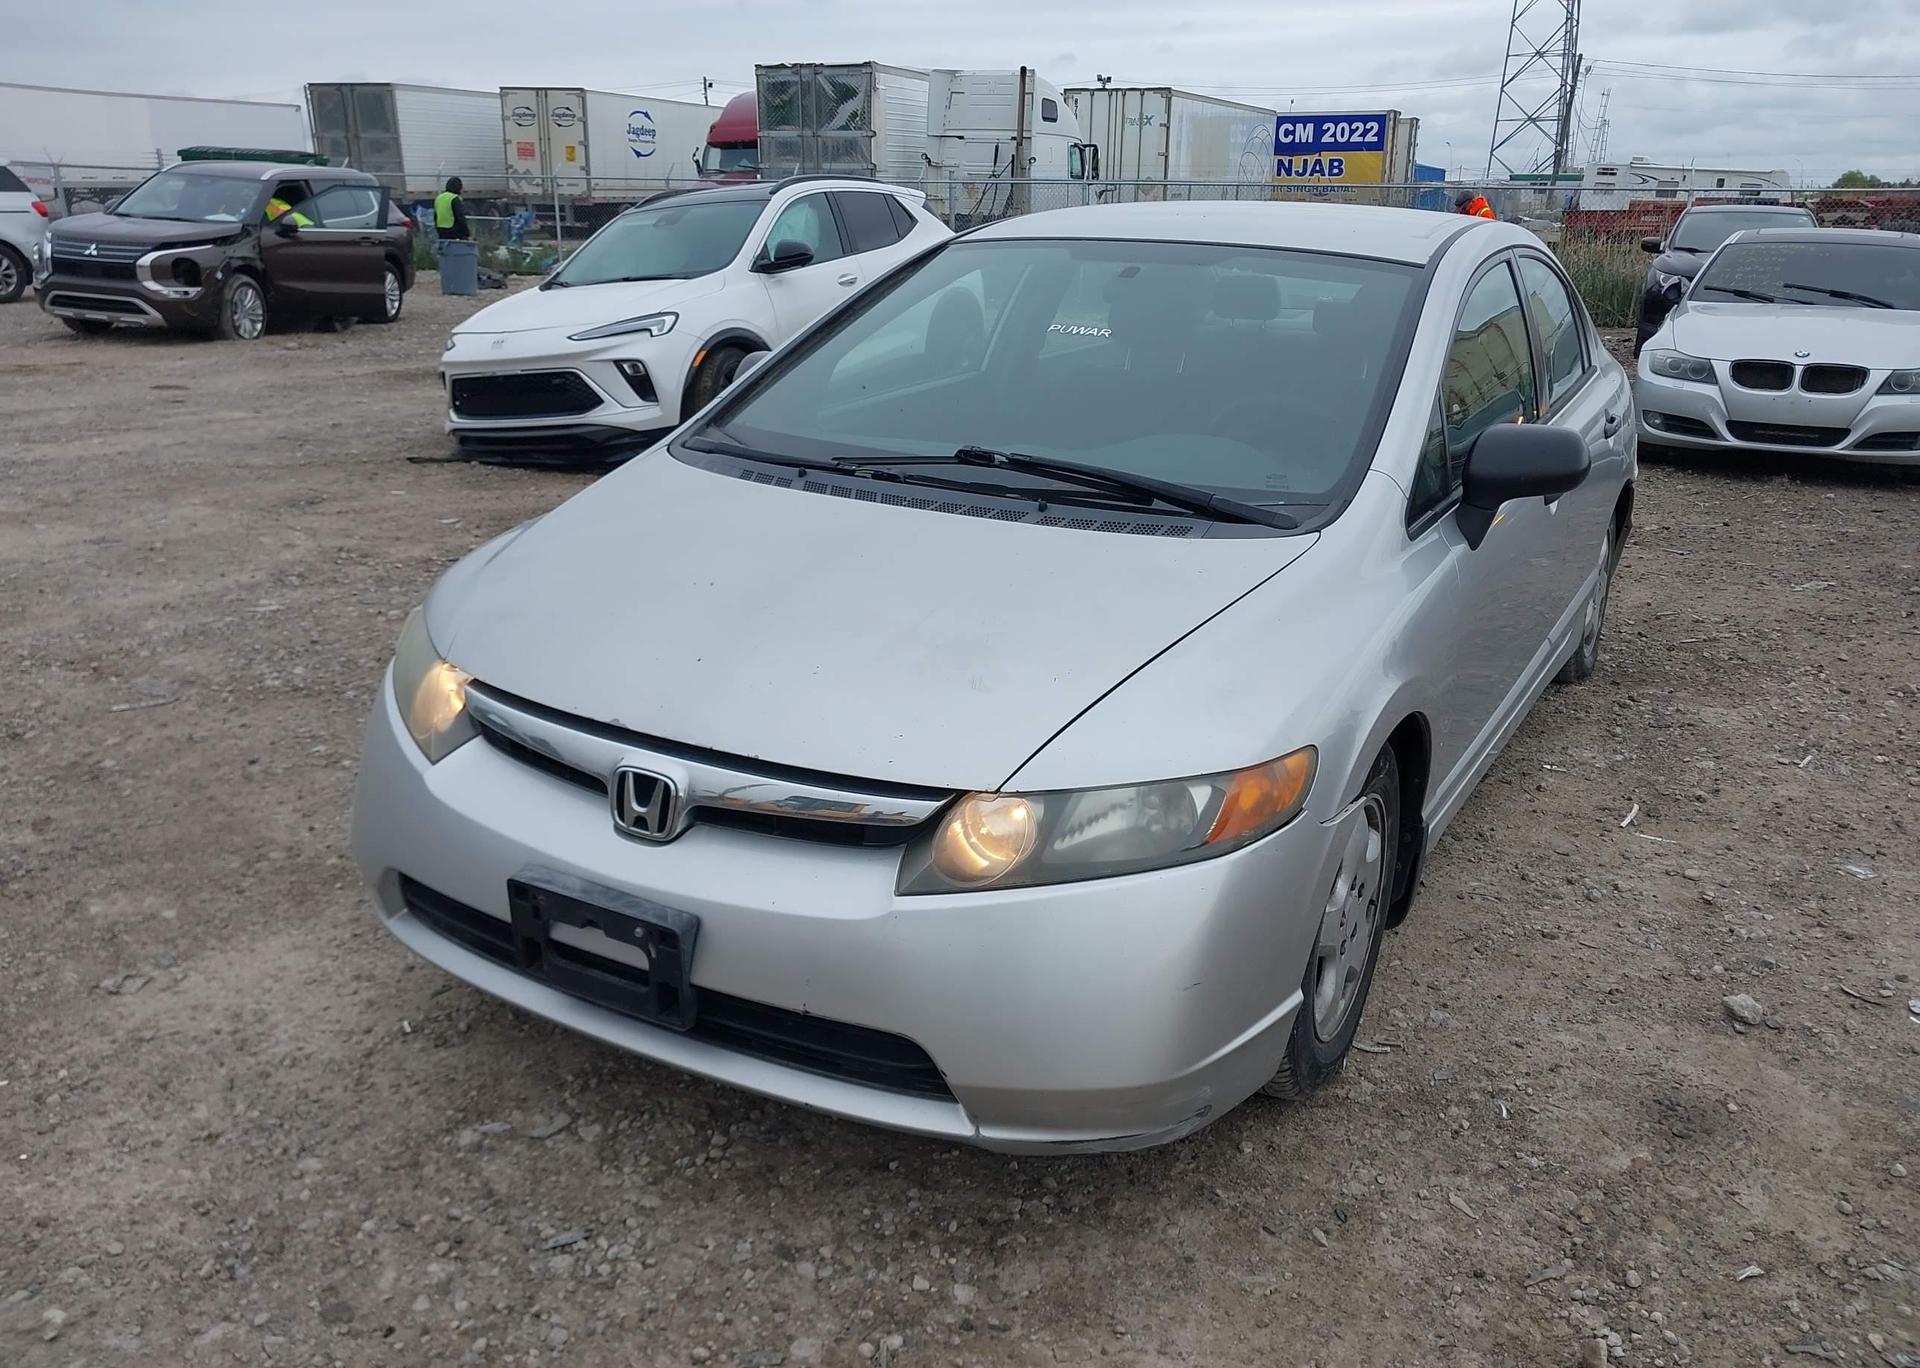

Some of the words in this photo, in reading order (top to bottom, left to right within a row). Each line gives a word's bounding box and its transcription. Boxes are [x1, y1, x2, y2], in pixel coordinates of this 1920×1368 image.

[626, 123, 656, 139] Jagdeep
[1278, 123, 1314, 143] CM
[1321, 121, 1379, 143] 2022
[1276, 158, 1345, 178] NJAB
[1047, 324, 1112, 337] PUWAR
